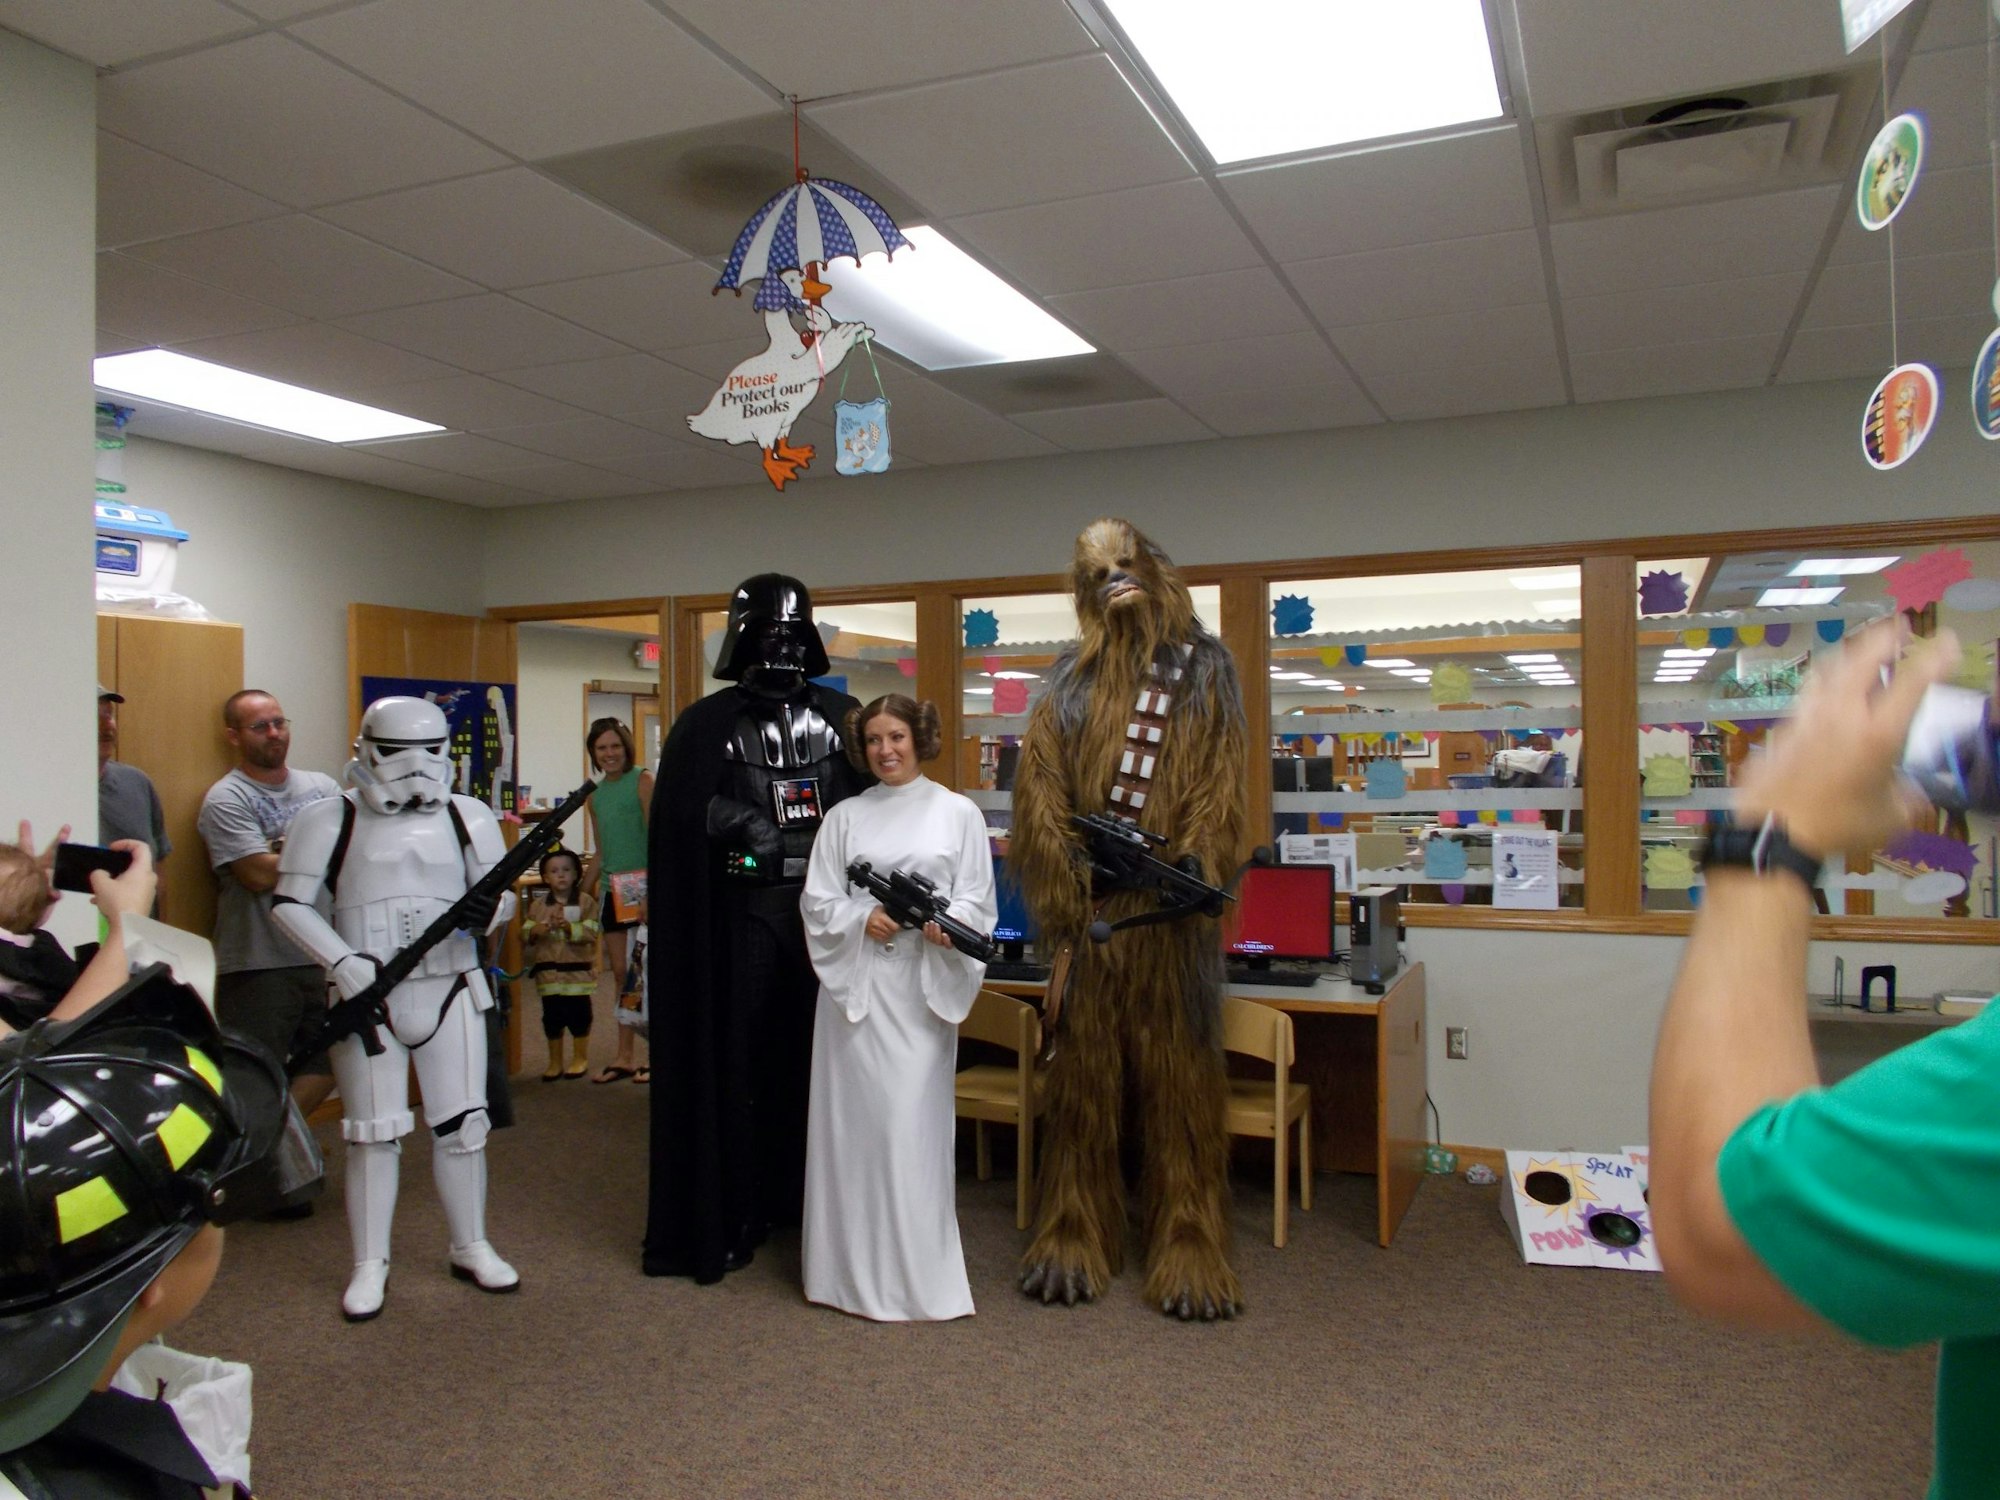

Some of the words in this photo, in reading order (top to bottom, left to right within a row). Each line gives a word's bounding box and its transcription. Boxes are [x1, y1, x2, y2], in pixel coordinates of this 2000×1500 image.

[728, 372, 777, 391] Please
[721, 385, 775, 407] Protect
[780, 382, 806, 397] our
[743, 399, 790, 419] Books
[1585, 1157, 1633, 1178] SPLAT
[1529, 1225, 1584, 1251] POW
